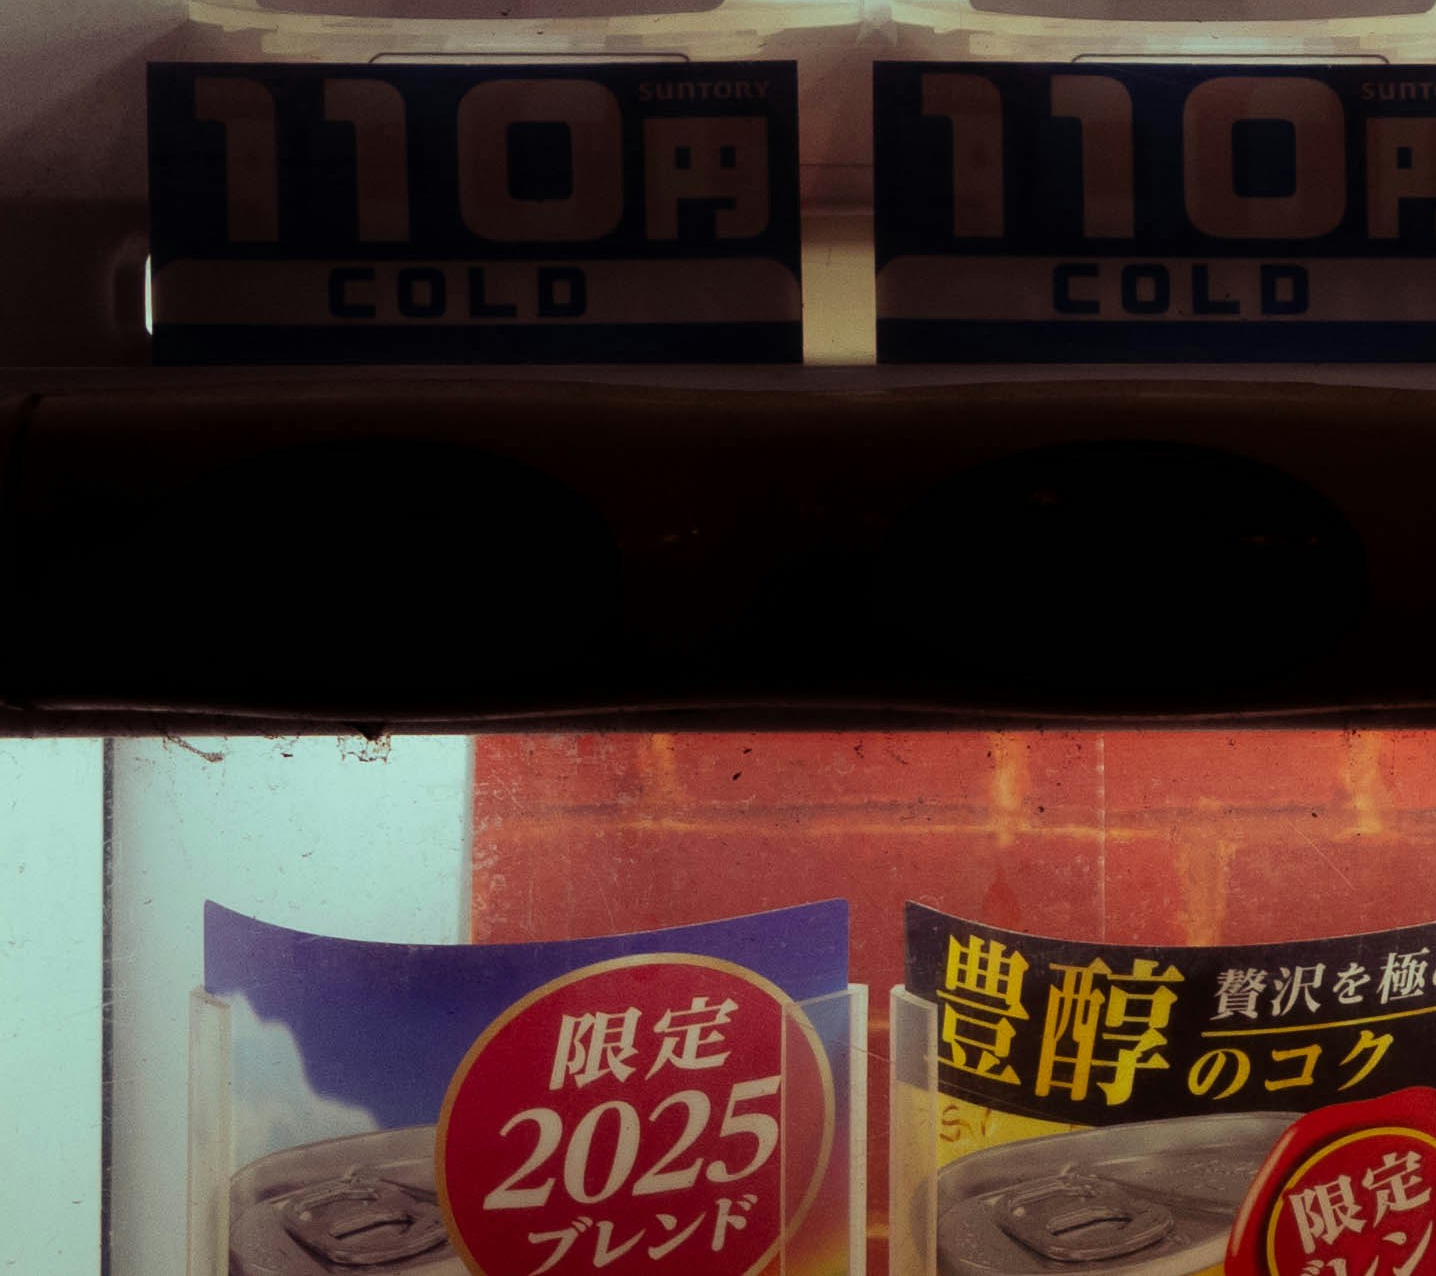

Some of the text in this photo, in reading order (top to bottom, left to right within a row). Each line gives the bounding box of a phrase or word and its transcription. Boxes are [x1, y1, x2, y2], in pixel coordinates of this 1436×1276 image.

[328, 267, 587, 320] COLD
[1051, 262, 1309, 317] COLD
[549, 996, 739, 1090] 限定
[924, 934, 1184, 1106] 豊醇
[1188, 1030, 1394, 1101] のコク
[483, 1075, 782, 1211] 2025
[528, 1194, 758, 1276] ブレンド
[1289, 1151, 1432, 1254] 限定
